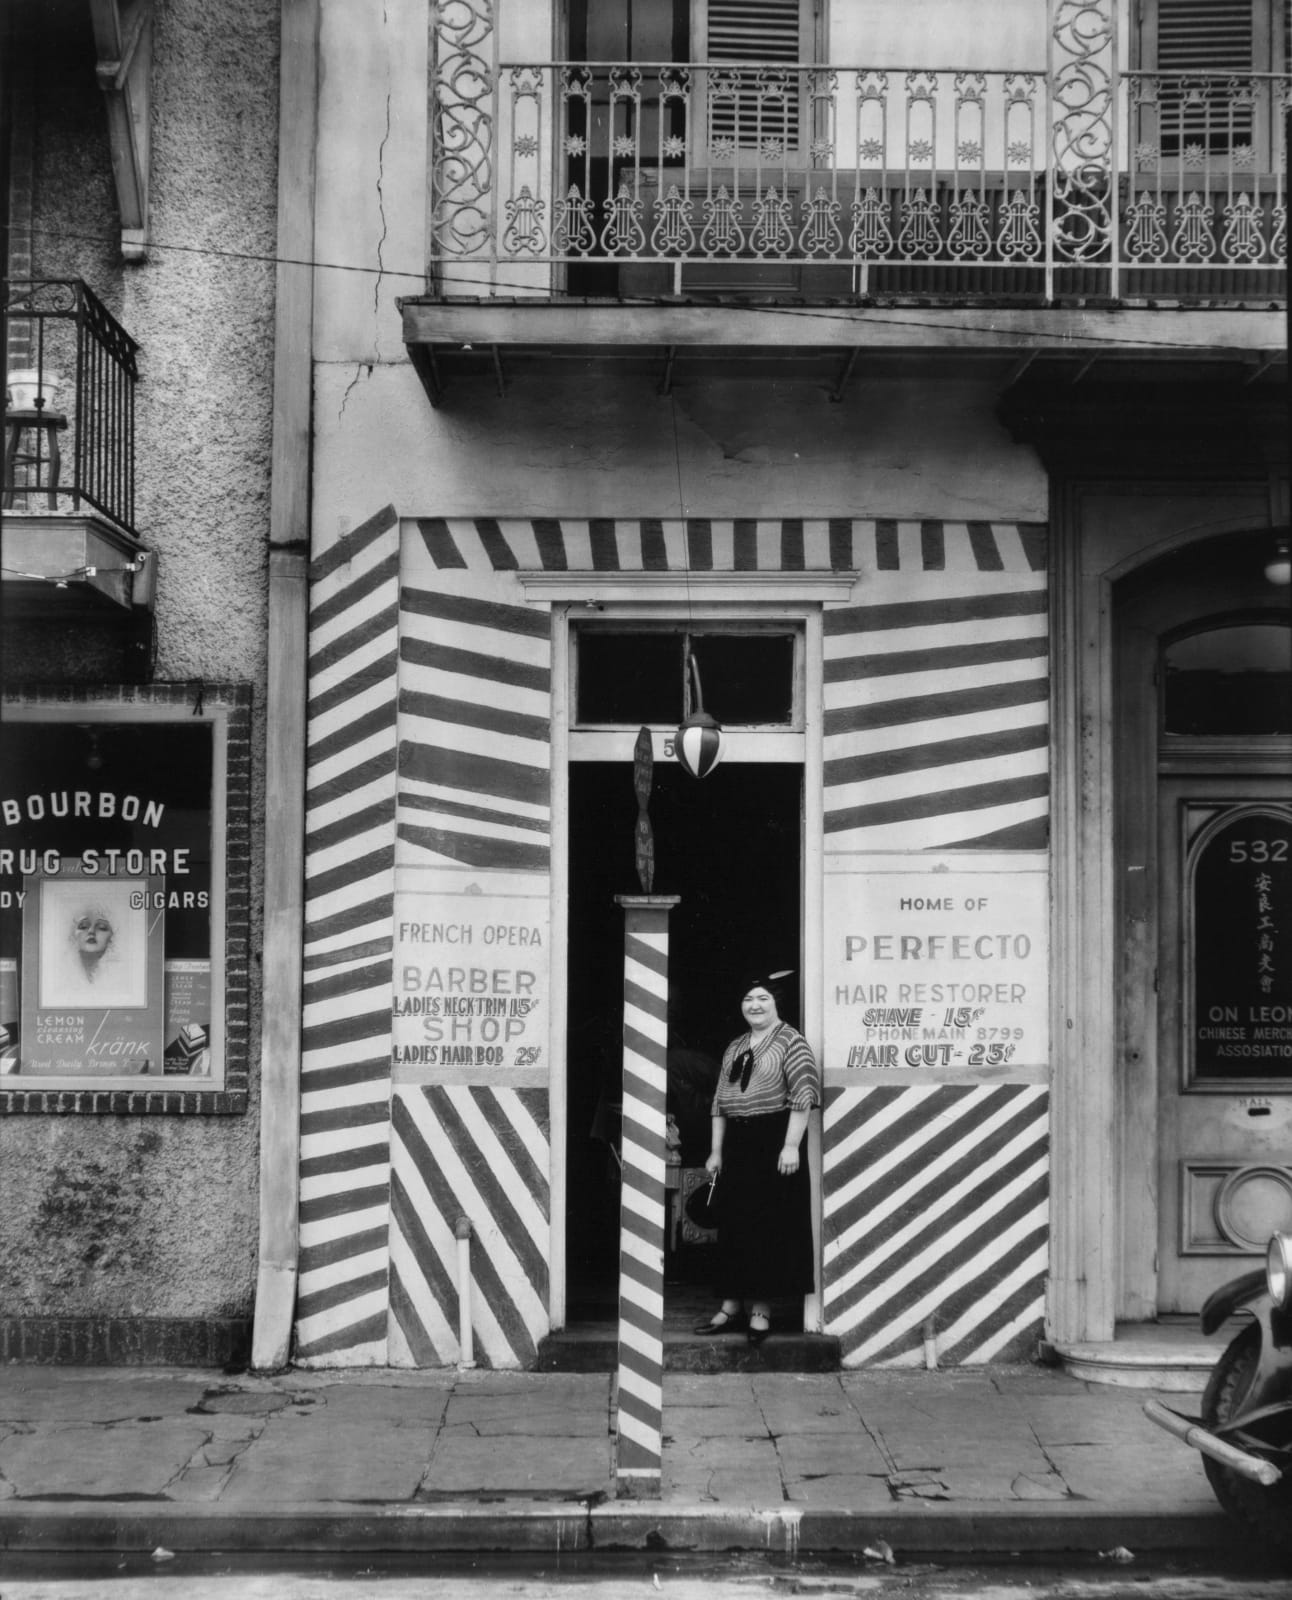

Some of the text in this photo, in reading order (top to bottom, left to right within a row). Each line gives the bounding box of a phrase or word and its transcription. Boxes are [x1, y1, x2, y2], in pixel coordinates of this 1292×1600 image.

[2, 791, 164, 828] BOURBON
[1230, 840, 1289, 863] 532
[82, 849, 191, 875] STORE
[130, 891, 209, 910] CIGARS
[900, 897, 989, 911] HOME OF
[400, 922, 542, 947] FRENCH OPERA
[845, 934, 1031, 961] PERFECTO
[402, 966, 536, 995] BARBER
[836, 983, 1026, 1005] HAIR RESTORER
[393, 996, 440, 1017] LADIES
[1209, 1006, 1238, 1022] ON
[37, 1016, 84, 1026] LEMON
[862, 1007, 923, 1027] SHAVE
[37, 1034, 84, 1044] CREAM
[423, 1016, 526, 1042] SHOP
[866, 1028, 1024, 1041] PHONE MAIN 8799
[1199, 1027, 1246, 1040] CHINESE
[392, 1045, 439, 1065] LADIES
[440, 1045, 474, 1065] HAIR
[475, 1046, 504, 1065] BOB
[847, 1044, 899, 1068] HAIR
[1239, 1097, 1273, 1107] MAIL
